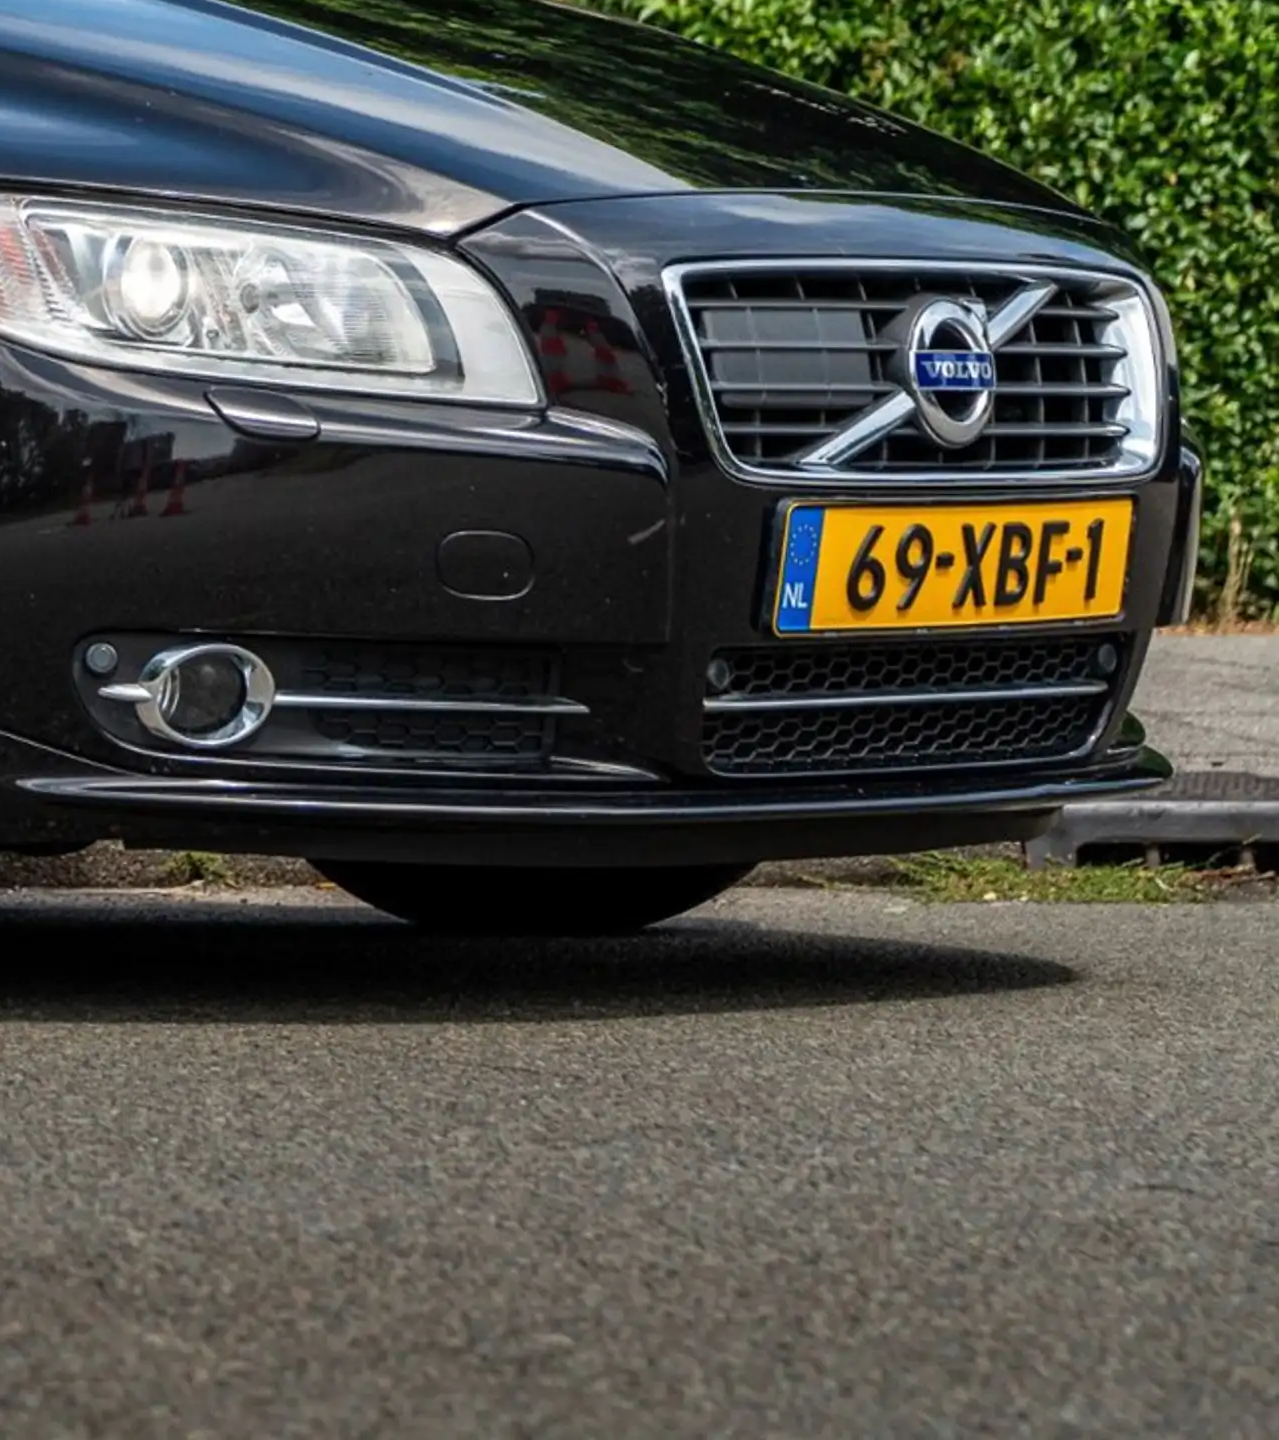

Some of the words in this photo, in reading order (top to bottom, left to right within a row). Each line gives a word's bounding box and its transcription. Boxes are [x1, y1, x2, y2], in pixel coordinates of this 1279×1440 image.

[920, 360, 992, 379] VOLVO
[846, 517, 1105, 612] 69-XBF-1
[782, 581, 809, 609] NL
